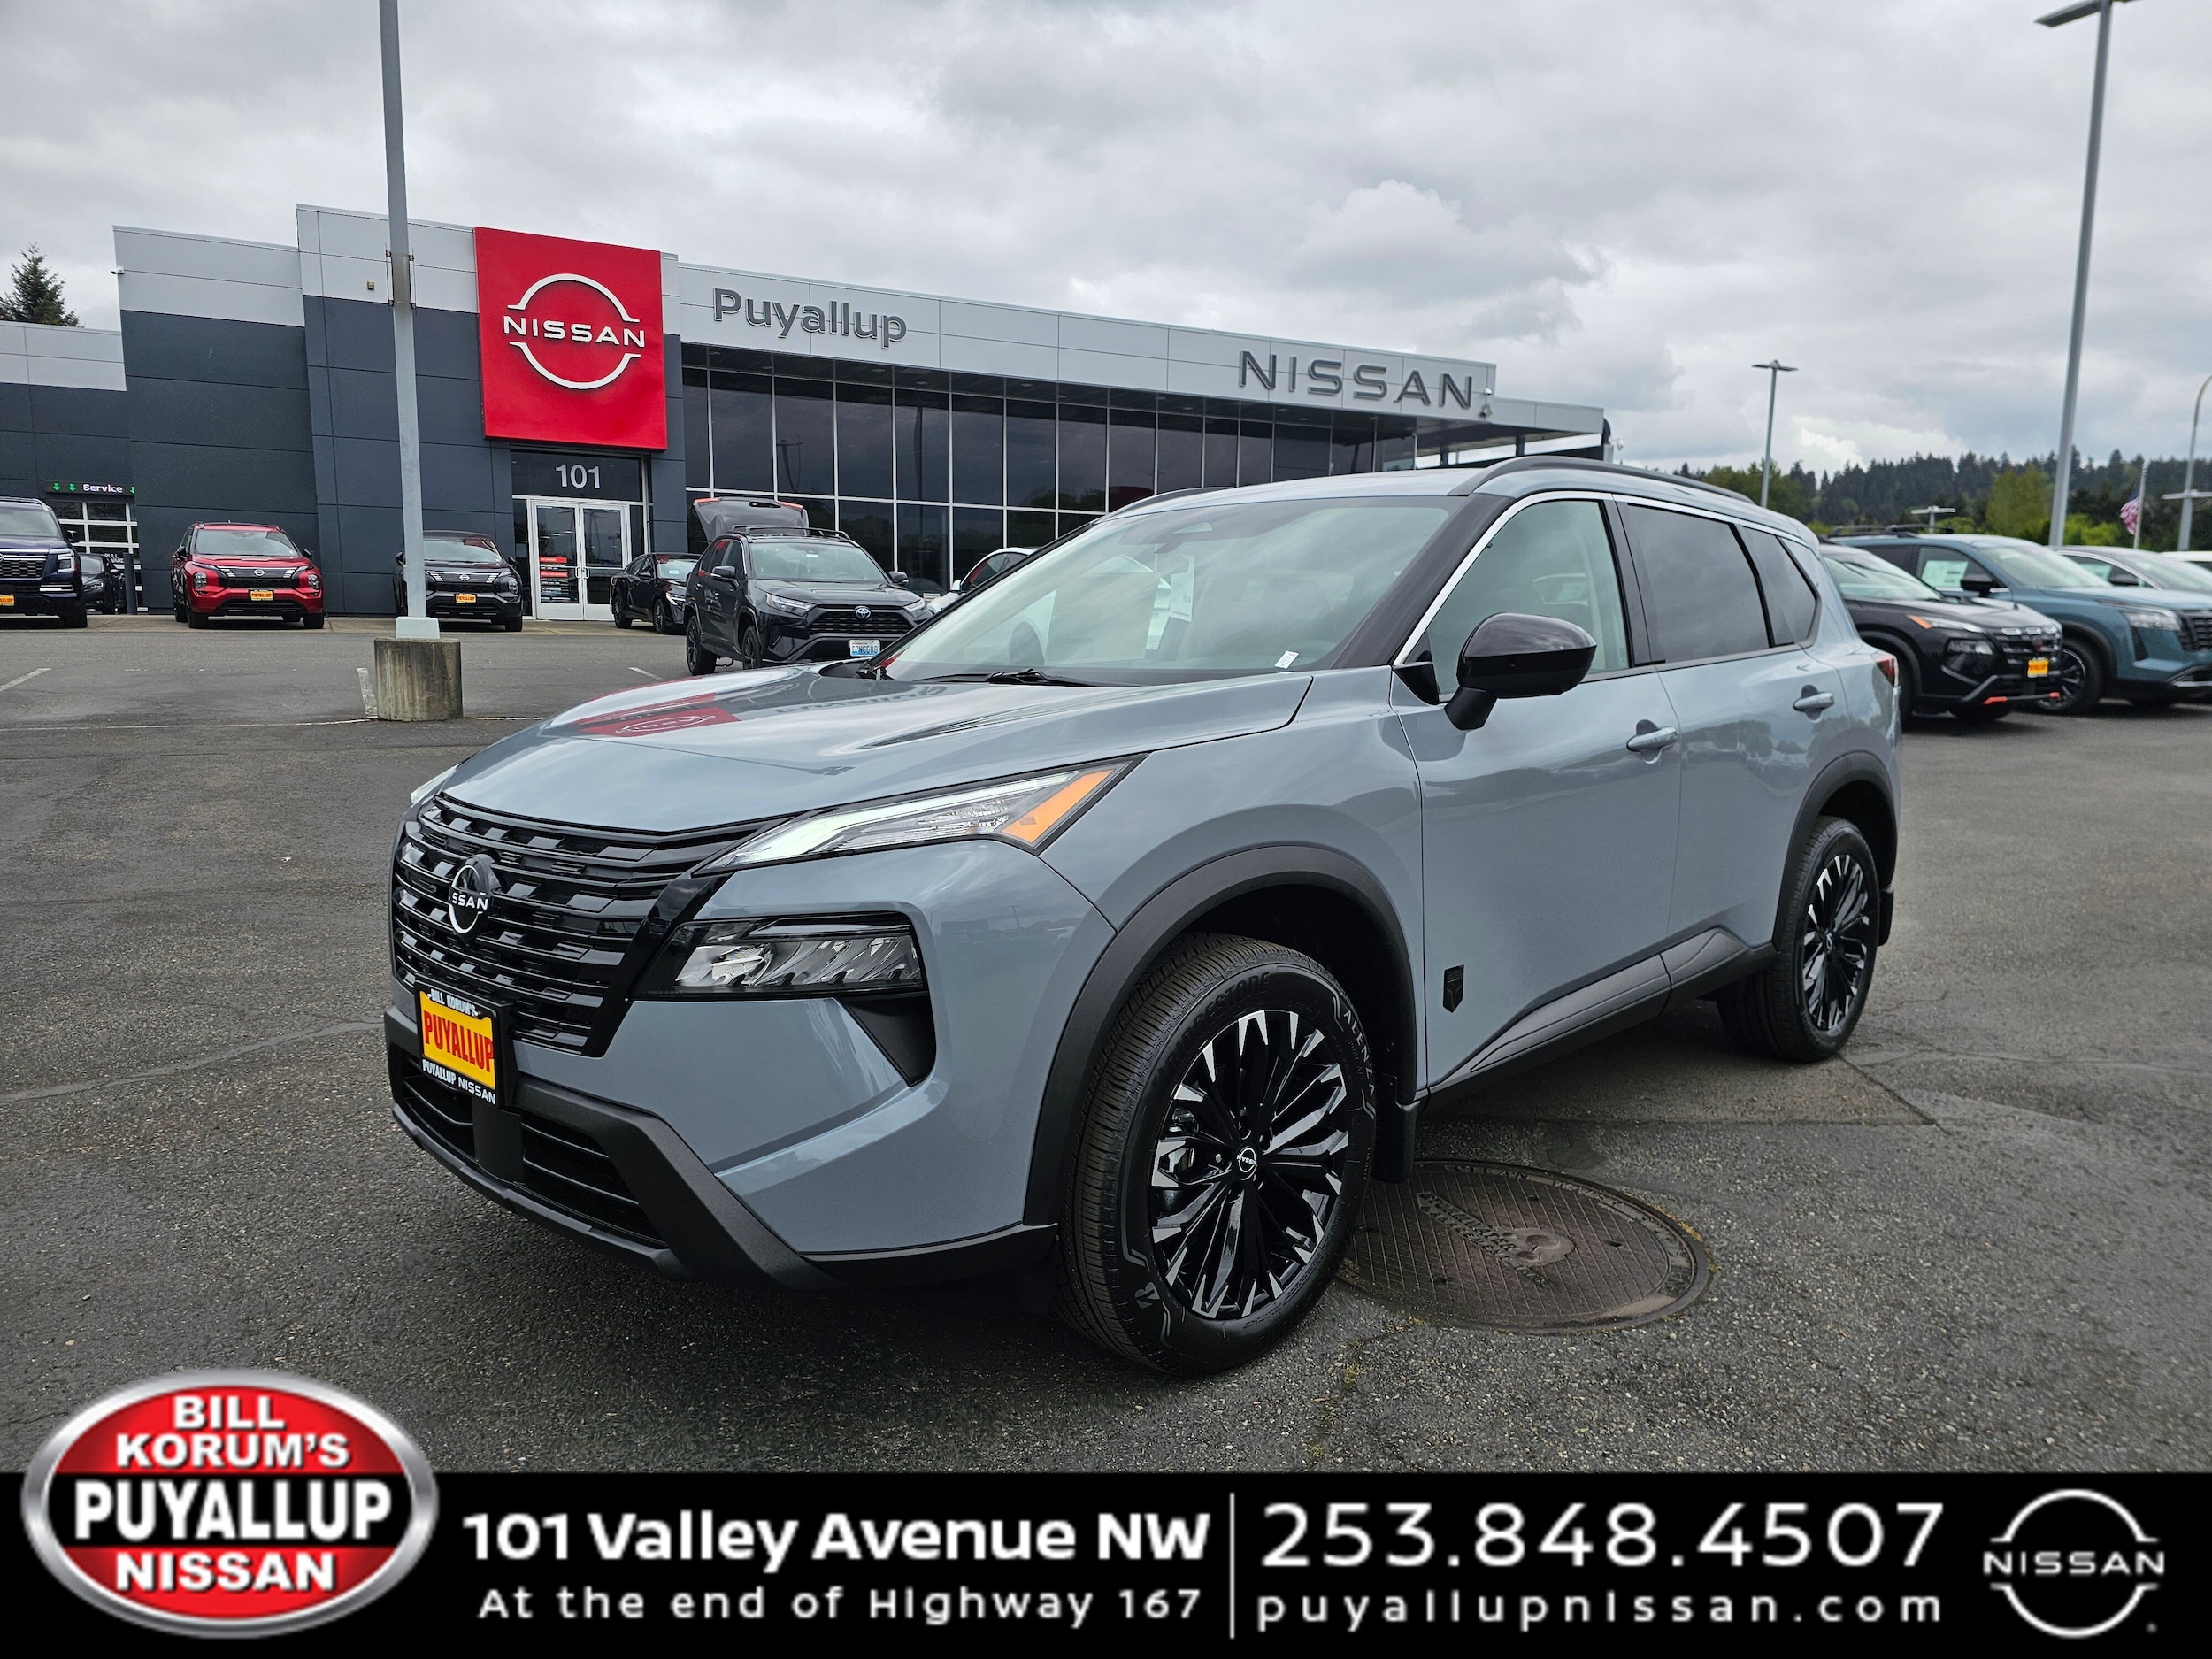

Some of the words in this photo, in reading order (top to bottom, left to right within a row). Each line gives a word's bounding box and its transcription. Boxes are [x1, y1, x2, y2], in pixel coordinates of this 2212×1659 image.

[503, 315, 645, 348] NISSAN
[713, 288, 907, 349] Puyallup
[1239, 350, 1472, 409] NISSAN
[82, 483, 123, 493] Service
[555, 464, 600, 488] 101
[430, 988, 445, 1005] BILL
[447, 995, 477, 1017] KORUM'S
[423, 1010, 494, 1072] PUYALLUP
[1343, 1010, 1375, 1097] ALENZA
[422, 1059, 457, 1085] PUYALLUP
[458, 1076, 495, 1105] NISSAN
